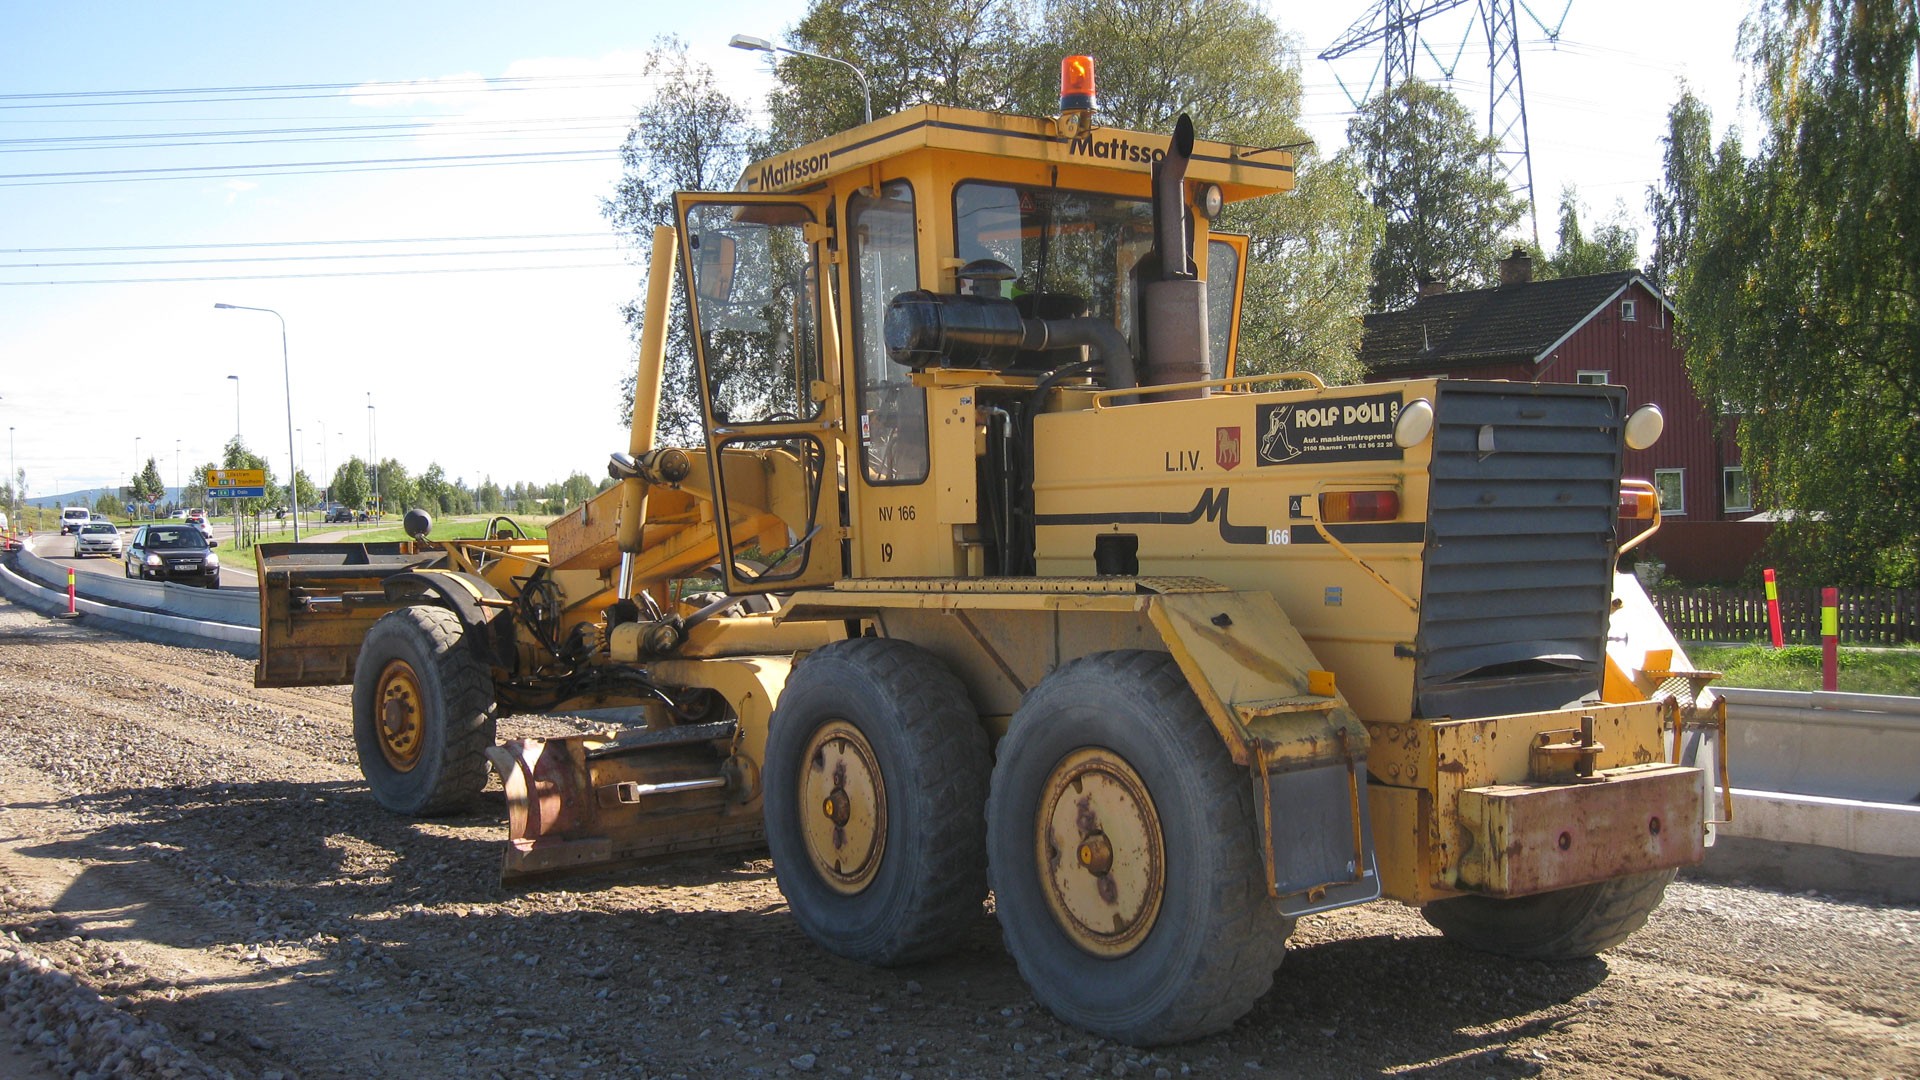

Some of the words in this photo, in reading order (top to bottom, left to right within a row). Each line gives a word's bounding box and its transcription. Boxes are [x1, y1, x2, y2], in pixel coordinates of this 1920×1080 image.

[1070, 133, 1168, 163] Mattsso
[761, 153, 829, 191] Mattsson
[1296, 406, 1340, 428] ROLF
[1343, 402, 1385, 425] DØLI
[1165, 450, 1204, 471] L.I.V.
[879, 506, 893, 521] NV
[898, 505, 916, 521] 166
[1268, 529, 1289, 545] 166
